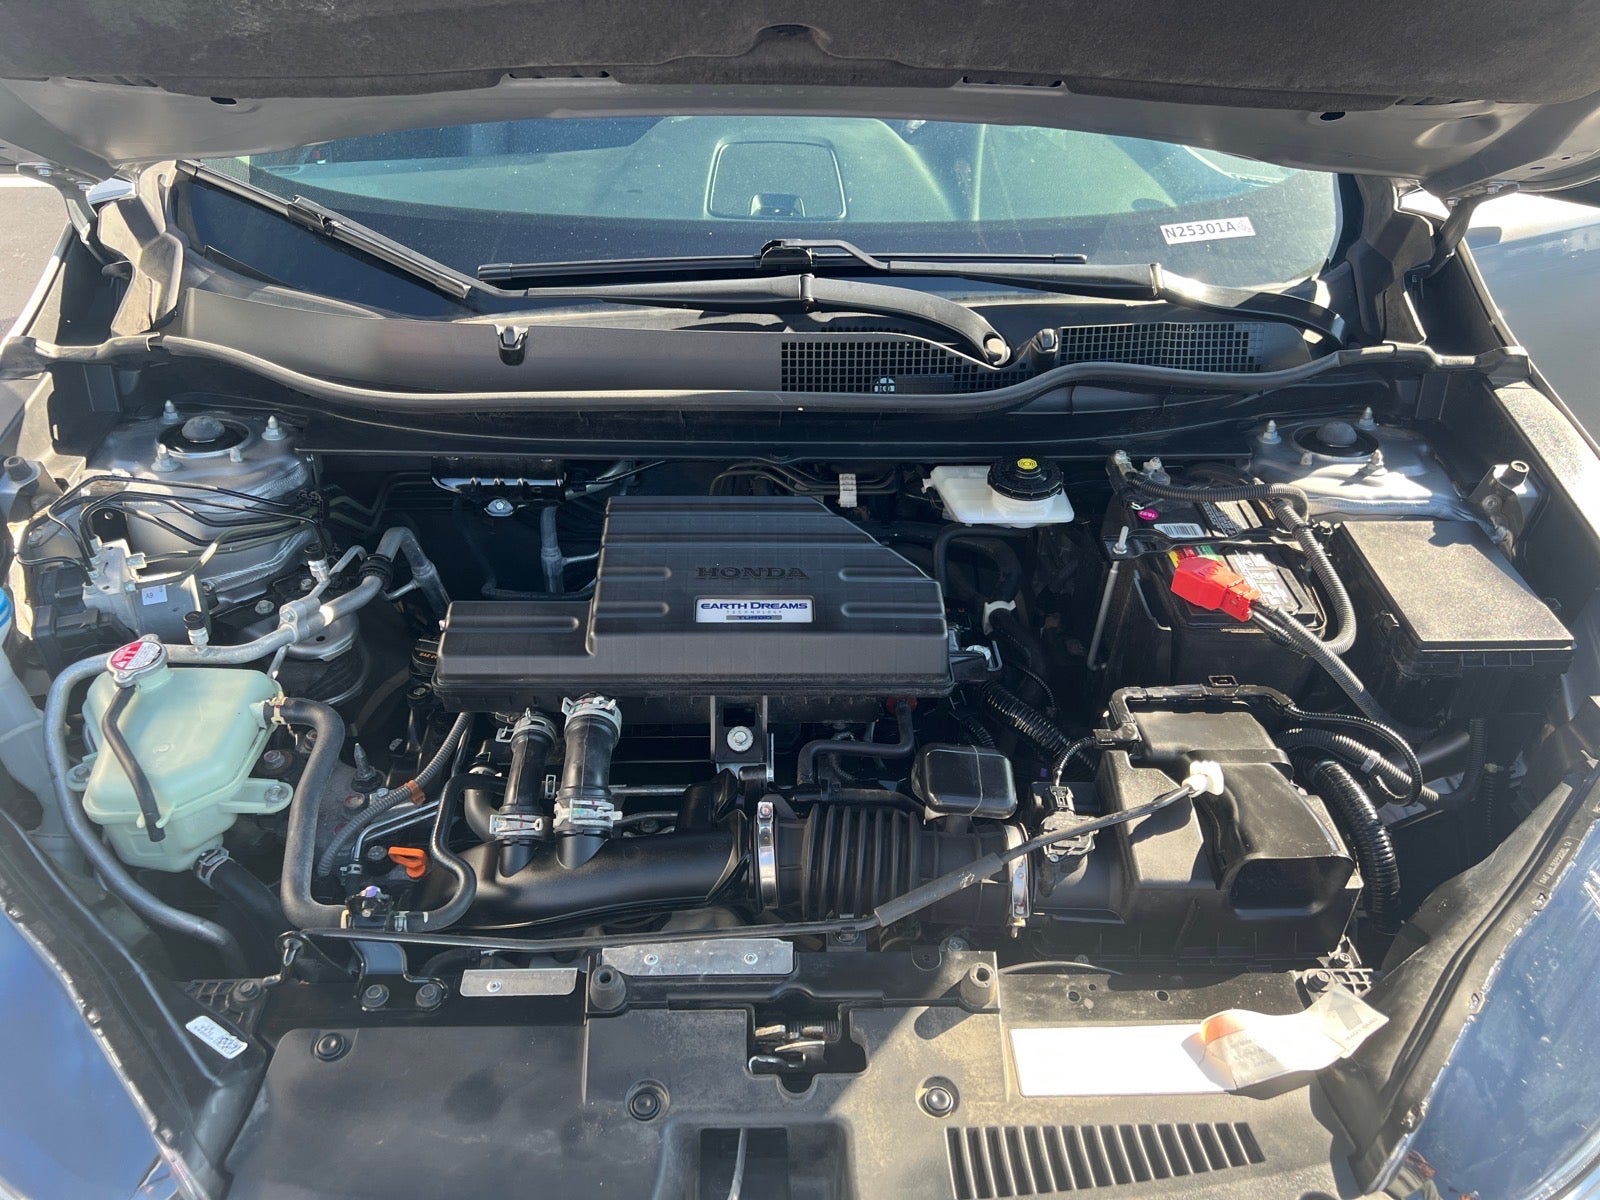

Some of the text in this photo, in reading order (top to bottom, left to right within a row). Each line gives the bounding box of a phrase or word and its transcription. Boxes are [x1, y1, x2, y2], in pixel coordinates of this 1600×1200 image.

[1164, 221, 1237, 239] N25301A
[696, 567, 809, 579] HONDA
[700, 601, 808, 610] EARTH DREAMS
